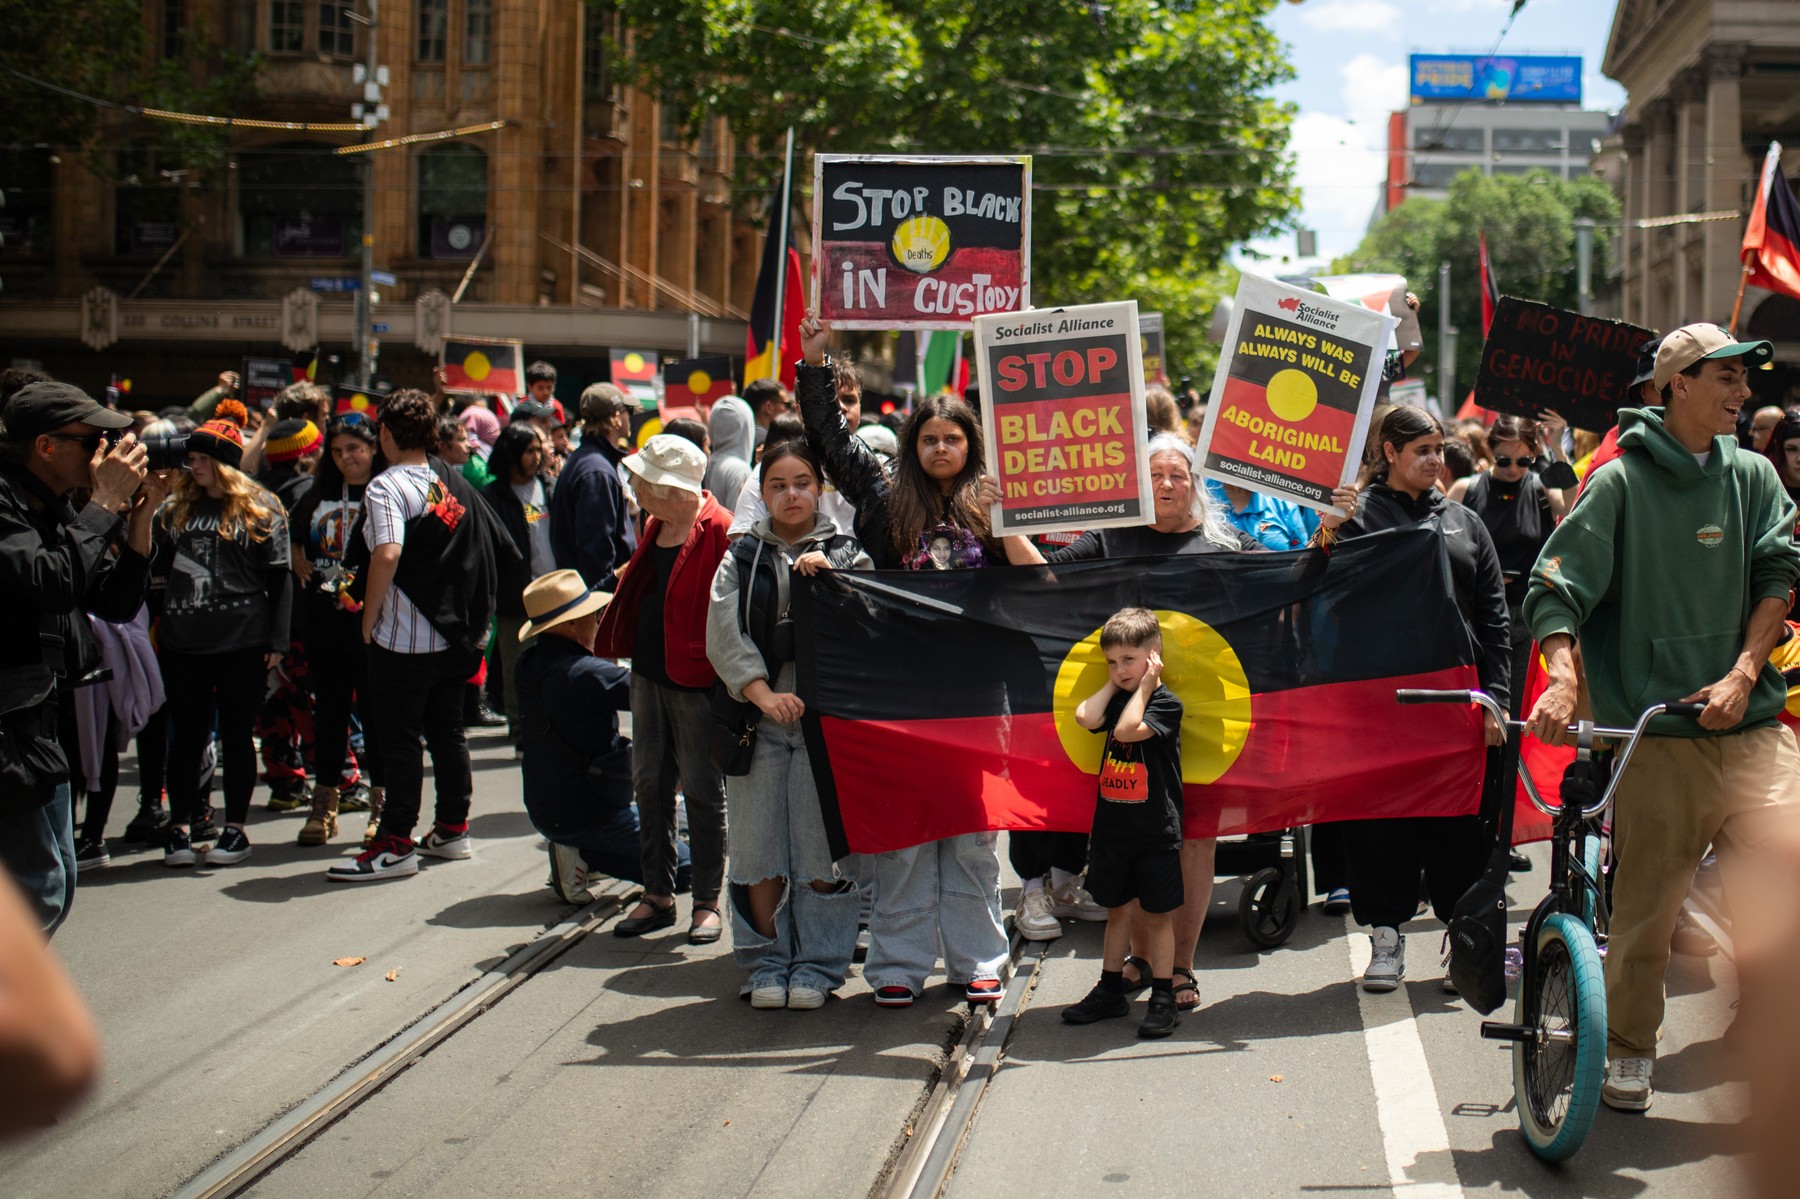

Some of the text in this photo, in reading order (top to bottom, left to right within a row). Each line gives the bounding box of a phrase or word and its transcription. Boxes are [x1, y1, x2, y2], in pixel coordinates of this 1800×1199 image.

[832, 181, 1022, 231] STOP BLACK
[907, 249, 933, 260] Deaths
[913, 273, 1019, 315] CUSTODY
[160, 315, 219, 328] COLLINS
[232, 317, 277, 329] STREET
[995, 317, 1114, 341] Socialist Alliance
[1296, 311, 1337, 330] Alliance
[1297, 302, 1340, 322] Socialist
[1254, 323, 1355, 364] ALWAYS WAS
[1515, 307, 1651, 359] NO PRIDE
[1550, 339, 1578, 361] IN
[997, 347, 1118, 392] STOP
[1238, 341, 1361, 390] ALWAYS WILL BE
[1000, 405, 1125, 445] BLACK
[1222, 405, 1343, 453] ABORIGINAL
[1004, 441, 1126, 476] DEATHS
[1248, 440, 1306, 470] LAND
[1006, 472, 1128, 499] IN CUSTODY
[1219, 460, 1322, 499] socialist-alliance.org
[1014, 503, 1126, 520] socialist-alliance.org
